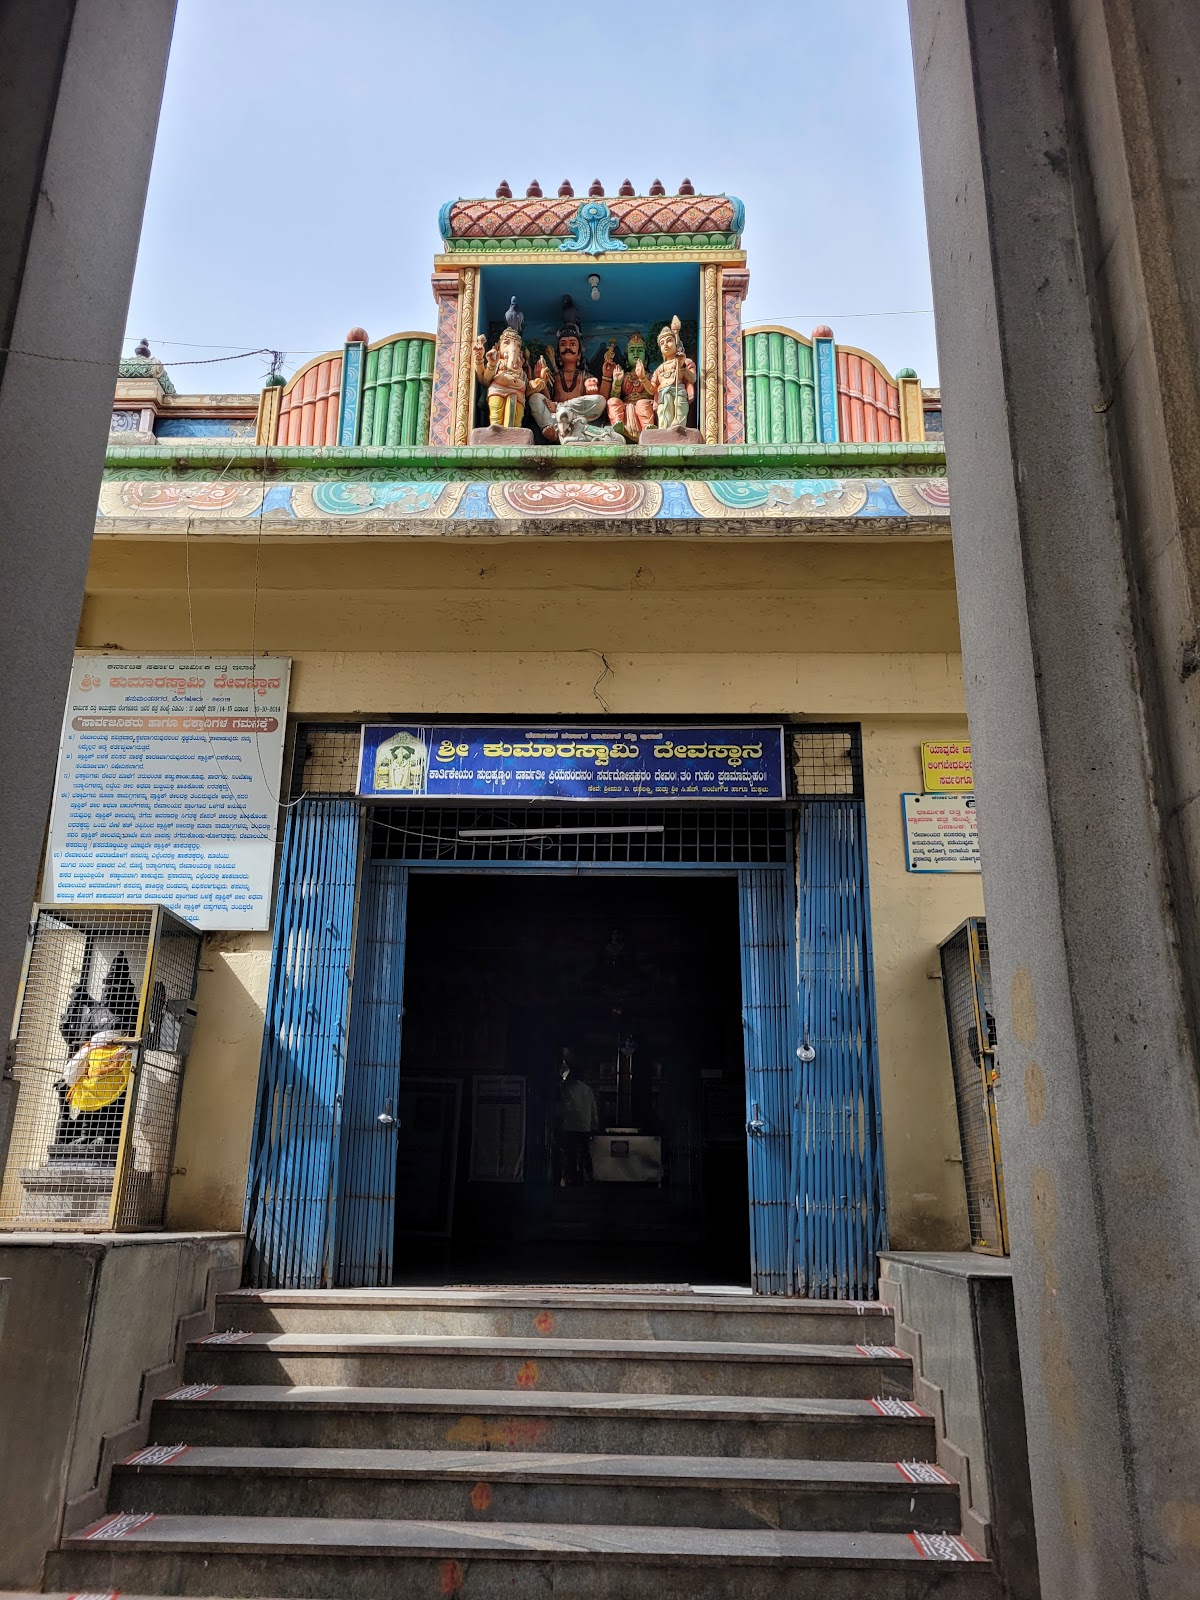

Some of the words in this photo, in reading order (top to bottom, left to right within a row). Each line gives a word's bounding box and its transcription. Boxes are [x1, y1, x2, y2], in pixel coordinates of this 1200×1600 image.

[80, 674, 101, 693] ಶ್ರೀ
[109, 675, 206, 695] ಕುಮಾರಸ್ವಾಮಿ
[214, 674, 281, 697] ದೇವಸ್ಥಾನ
[148, 718, 178, 728] ಹಾಗೂ
[436, 740, 469, 763] ಶ್ರೀ
[483, 740, 639, 766] ಕುಮಾರಸ್ವಾಮಿ
[654, 741, 763, 768] ದೇವಸ್ಥಾನ
[429, 767, 474, 780] ಕಾರ್ತಿಕೇಯಂ
[680, 771, 691, 781] ತಂ
[695, 771, 715, 782] ಗುಹಂ
